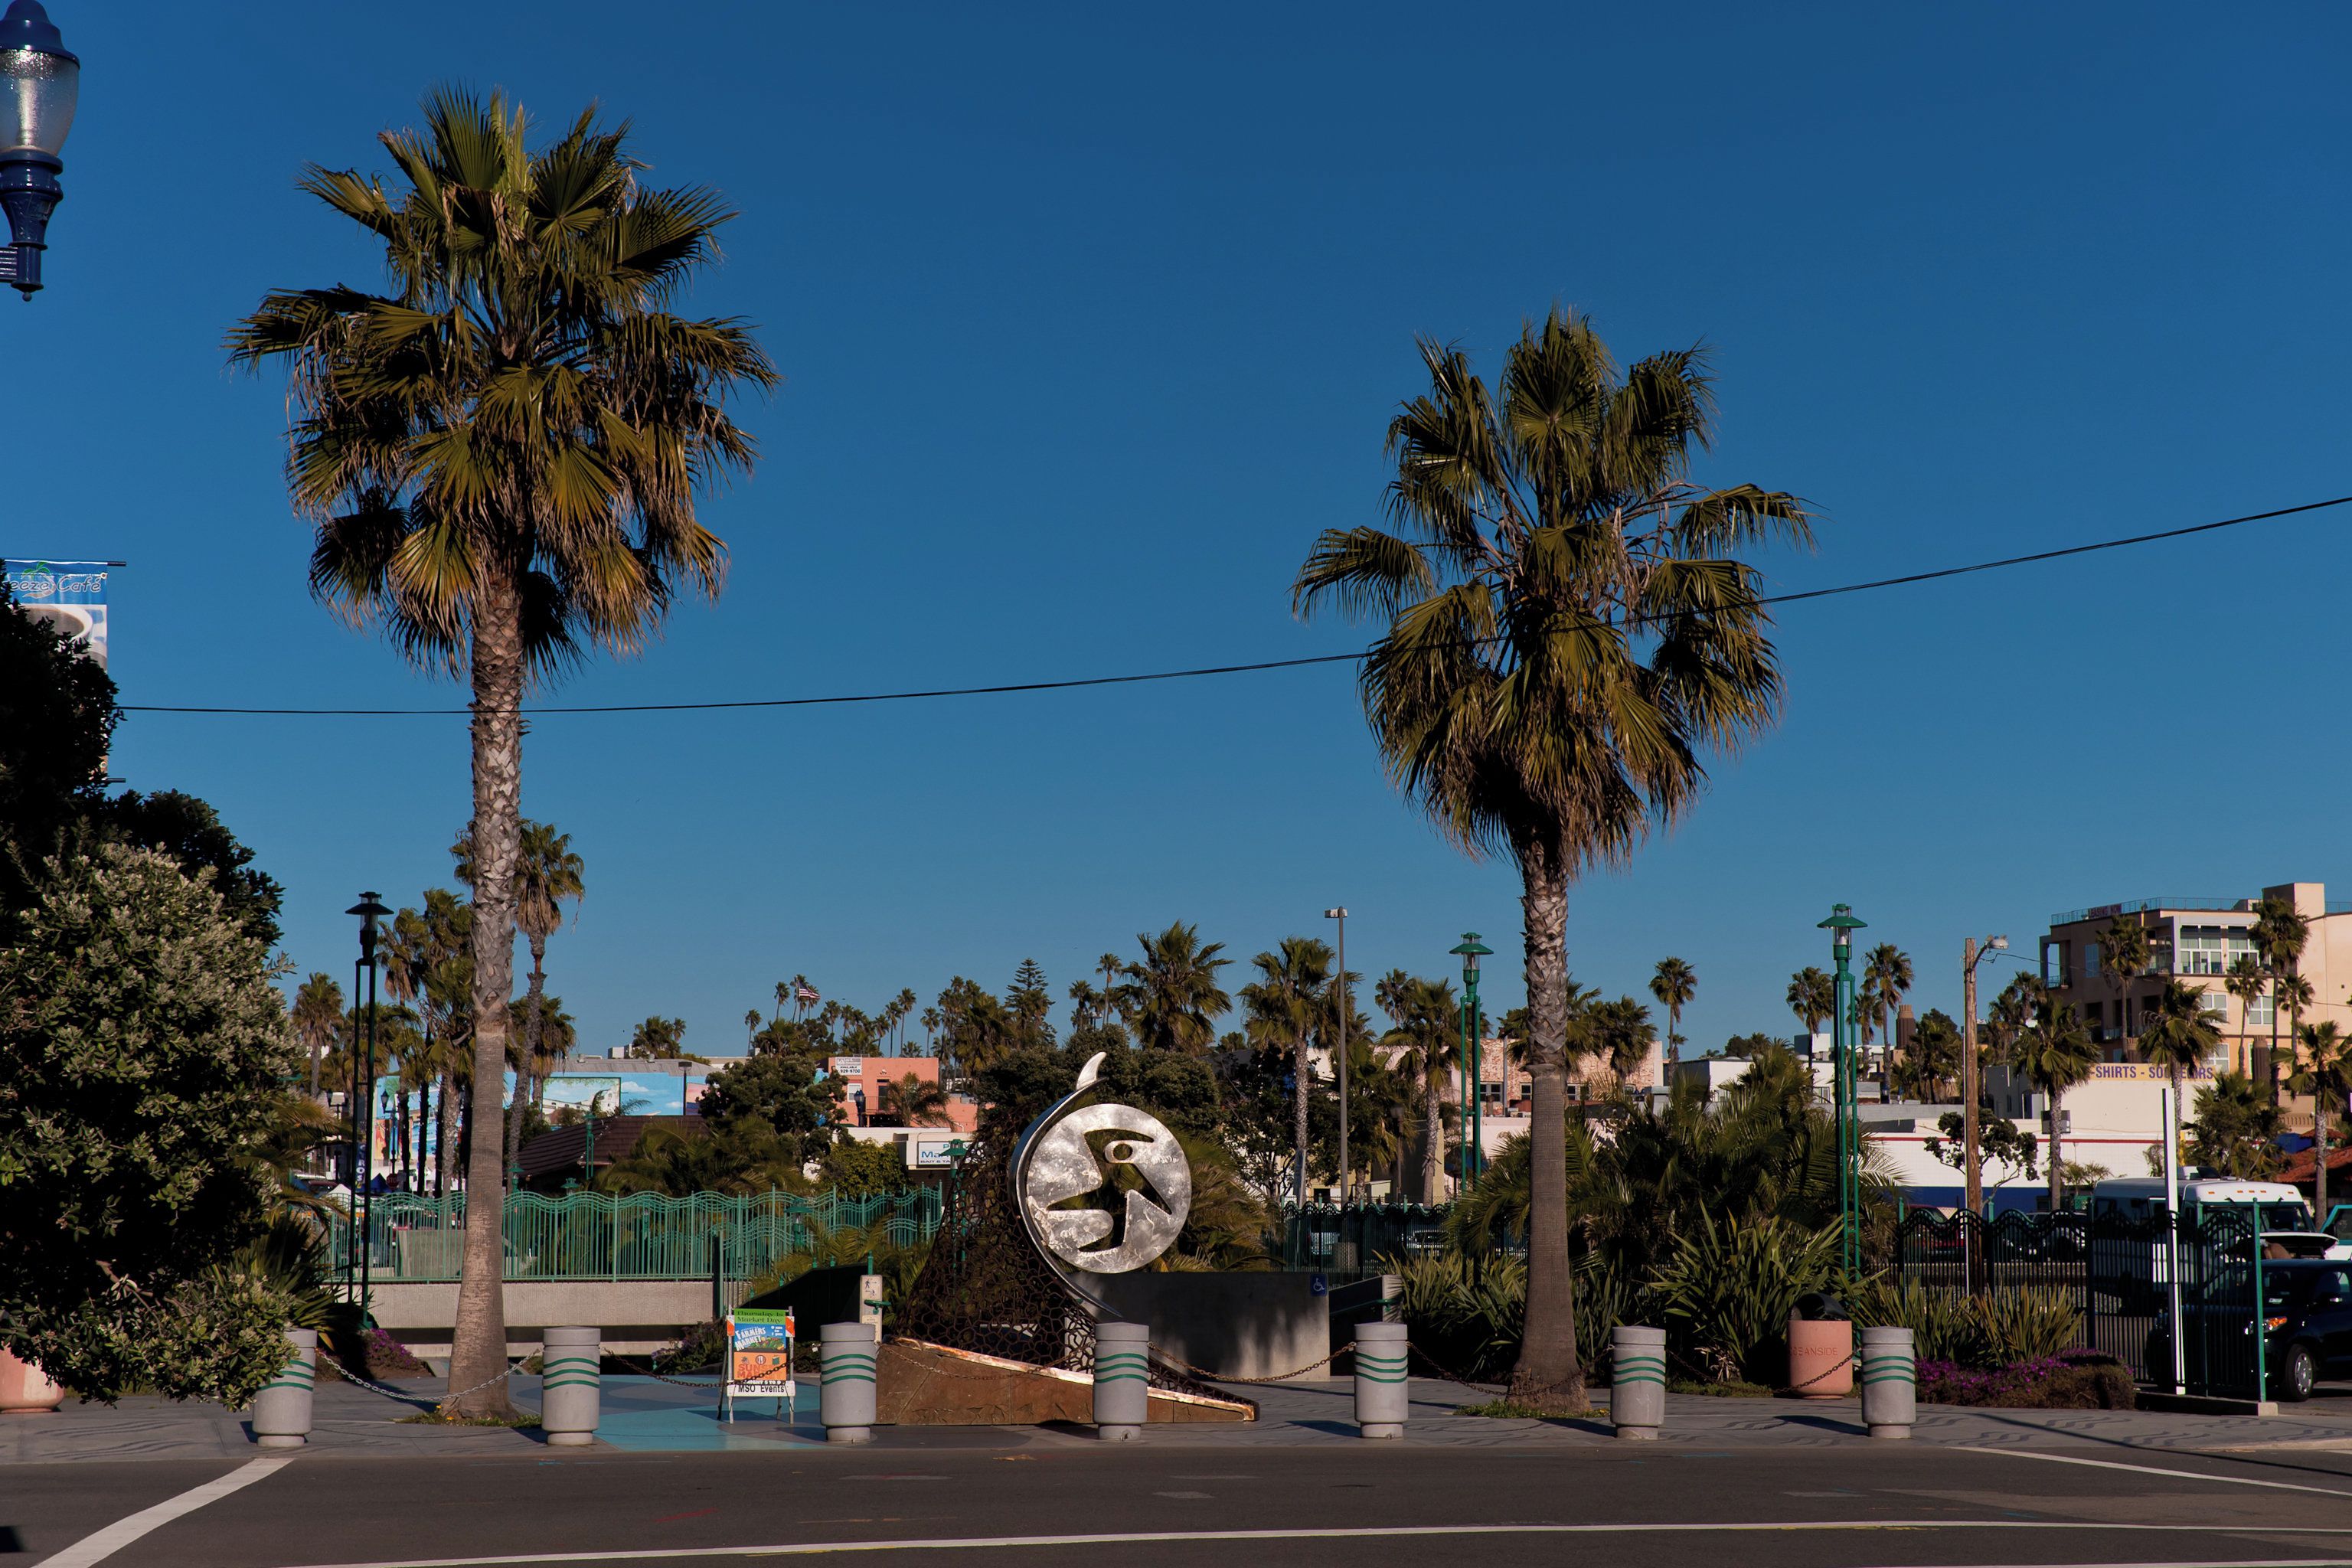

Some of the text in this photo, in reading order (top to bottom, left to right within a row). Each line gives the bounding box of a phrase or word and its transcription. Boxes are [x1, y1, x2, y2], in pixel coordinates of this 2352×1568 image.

[57, 576, 102, 593] Café
[2091, 1066, 2137, 1078] -SHIRTS
[2148, 1066, 2213, 1080] SOUEIRS
[735, 1327, 766, 1340] FARMERS
[735, 1335, 762, 1351] MARKET
[738, 1384, 785, 1393] MSO Events
